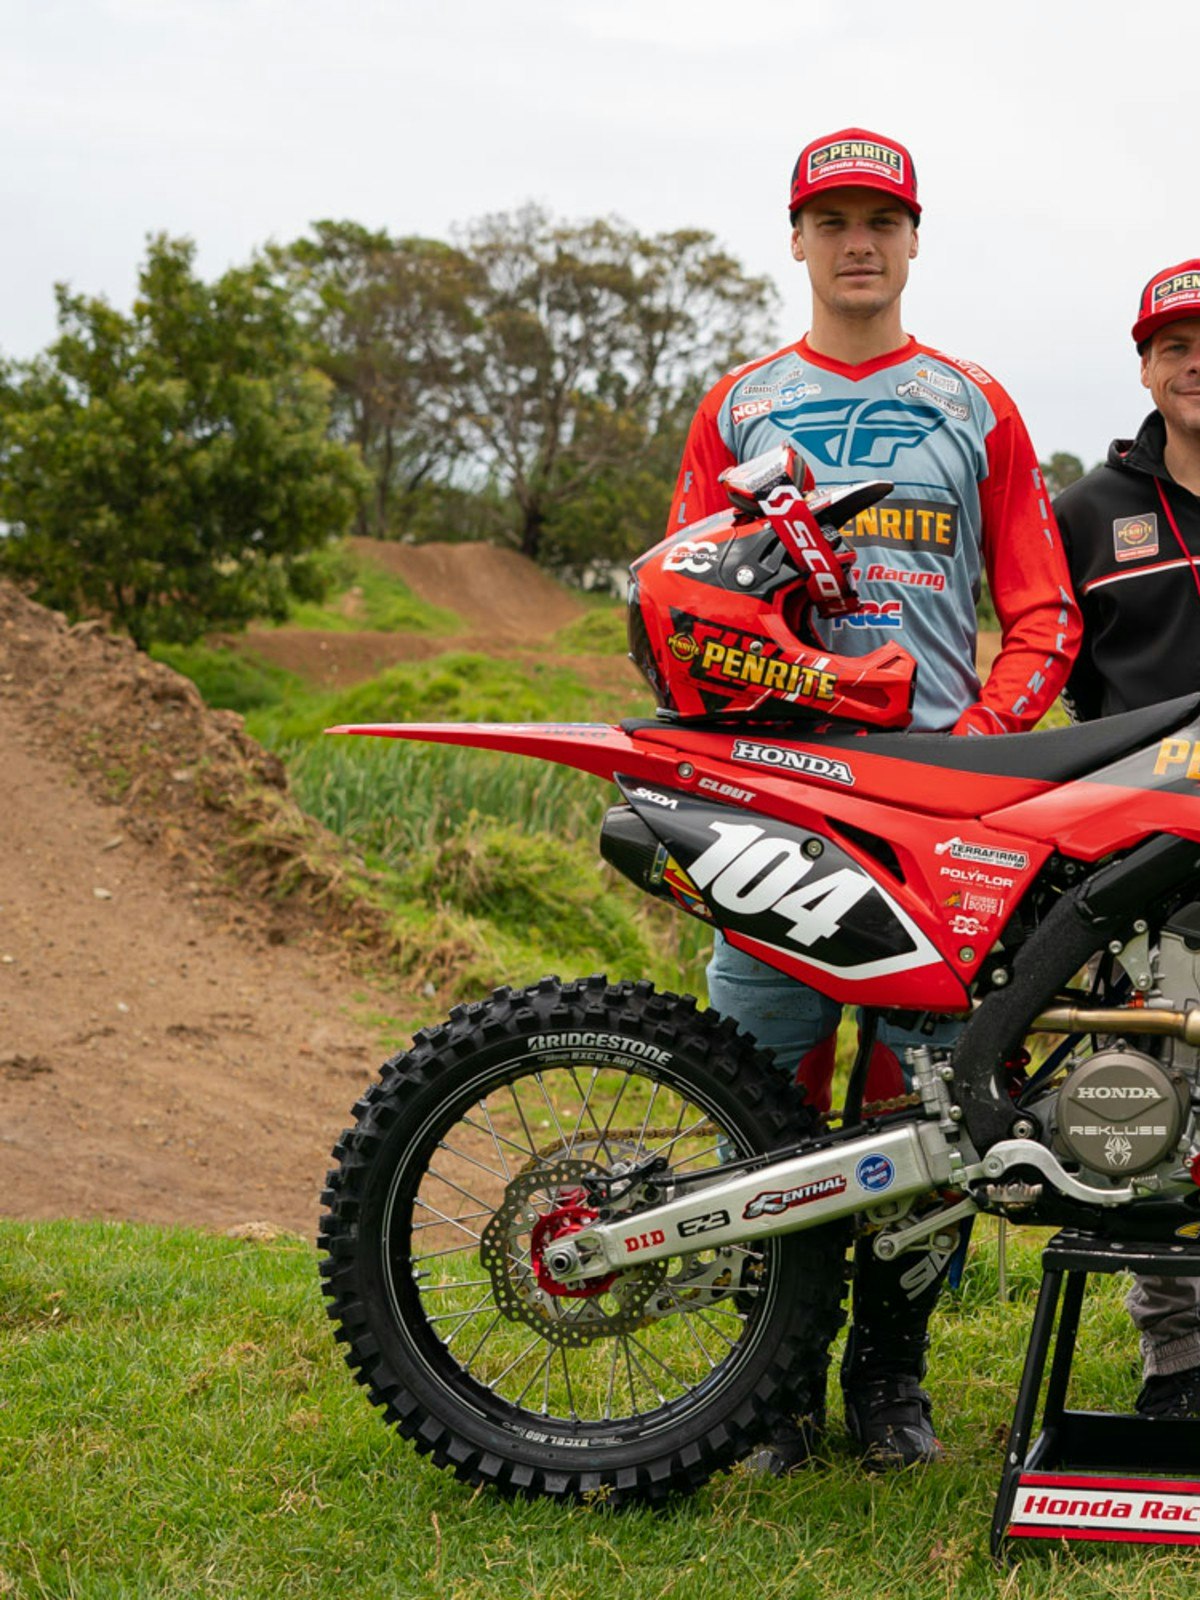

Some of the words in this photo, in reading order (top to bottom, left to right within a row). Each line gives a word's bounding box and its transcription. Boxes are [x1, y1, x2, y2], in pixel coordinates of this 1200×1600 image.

[829, 143, 899, 168] PENRITE
[855, 160, 892, 175] Racing
[732, 400, 772, 424] NGK
[866, 564, 945, 591] Racing
[702, 641, 838, 699] PENRITE
[734, 742, 852, 783] HONDA
[698, 777, 757, 803] CLOUT
[951, 844, 1026, 864] TERRAFIRMA
[686, 821, 874, 947] 104
[940, 866, 1014, 888] POLYFLOR
[527, 1032, 673, 1066] BRIDGESTONE
[570, 1051, 611, 1063] EXCEL
[1077, 1087, 1162, 1099] HONDA
[1069, 1125, 1168, 1136] REKLUSE
[624, 1230, 665, 1253] DID
[1023, 1495, 1133, 1519] Honda
